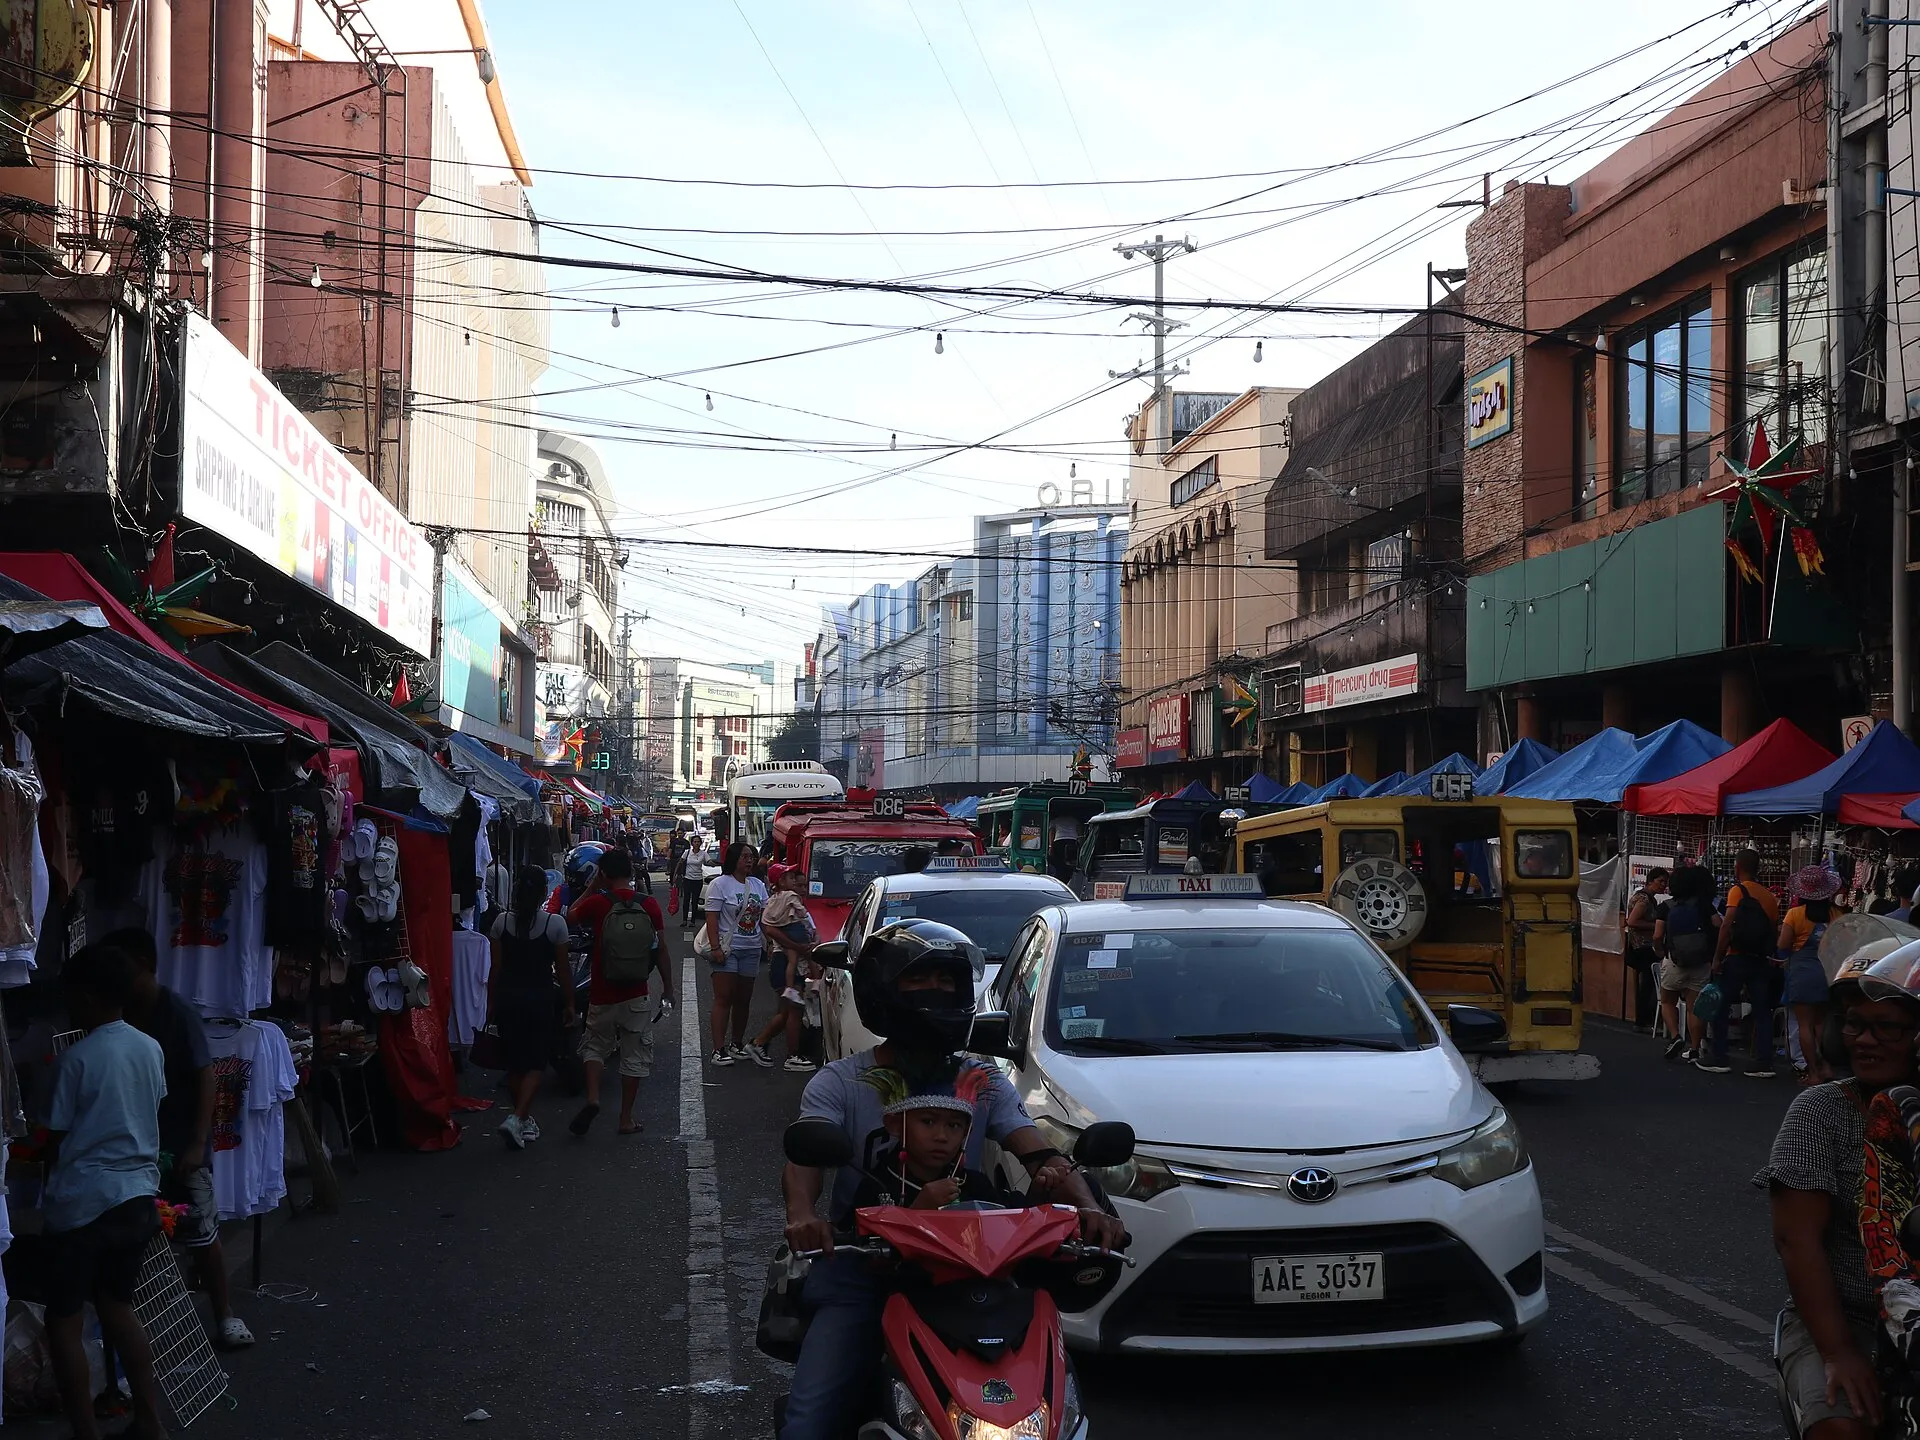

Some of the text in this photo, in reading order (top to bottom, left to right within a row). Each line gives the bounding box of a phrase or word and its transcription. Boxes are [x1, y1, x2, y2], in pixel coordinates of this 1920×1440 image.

[249, 377, 351, 509] TICKET
[358, 487, 417, 571] OFFICE
[195, 435, 275, 538] SHIPPING & AIRLINE
[1371, 541, 1402, 568] AVON
[1334, 667, 1388, 694] mercury drug
[1156, 736, 1181, 749] PAWNSHOP
[1069, 780, 1087, 795] 17B
[1224, 787, 1250, 800] 12C
[1432, 774, 1472, 799] 06F
[873, 798, 904, 816] 08G
[934, 858, 999, 867] VACANT TAXI OCCUPIED
[1139, 878, 1253, 892] VACANT TAXI OCCUPIED
[1261, 1262, 1376, 1292] AAE 3037
[1300, 1292, 1331, 1300] REGION
